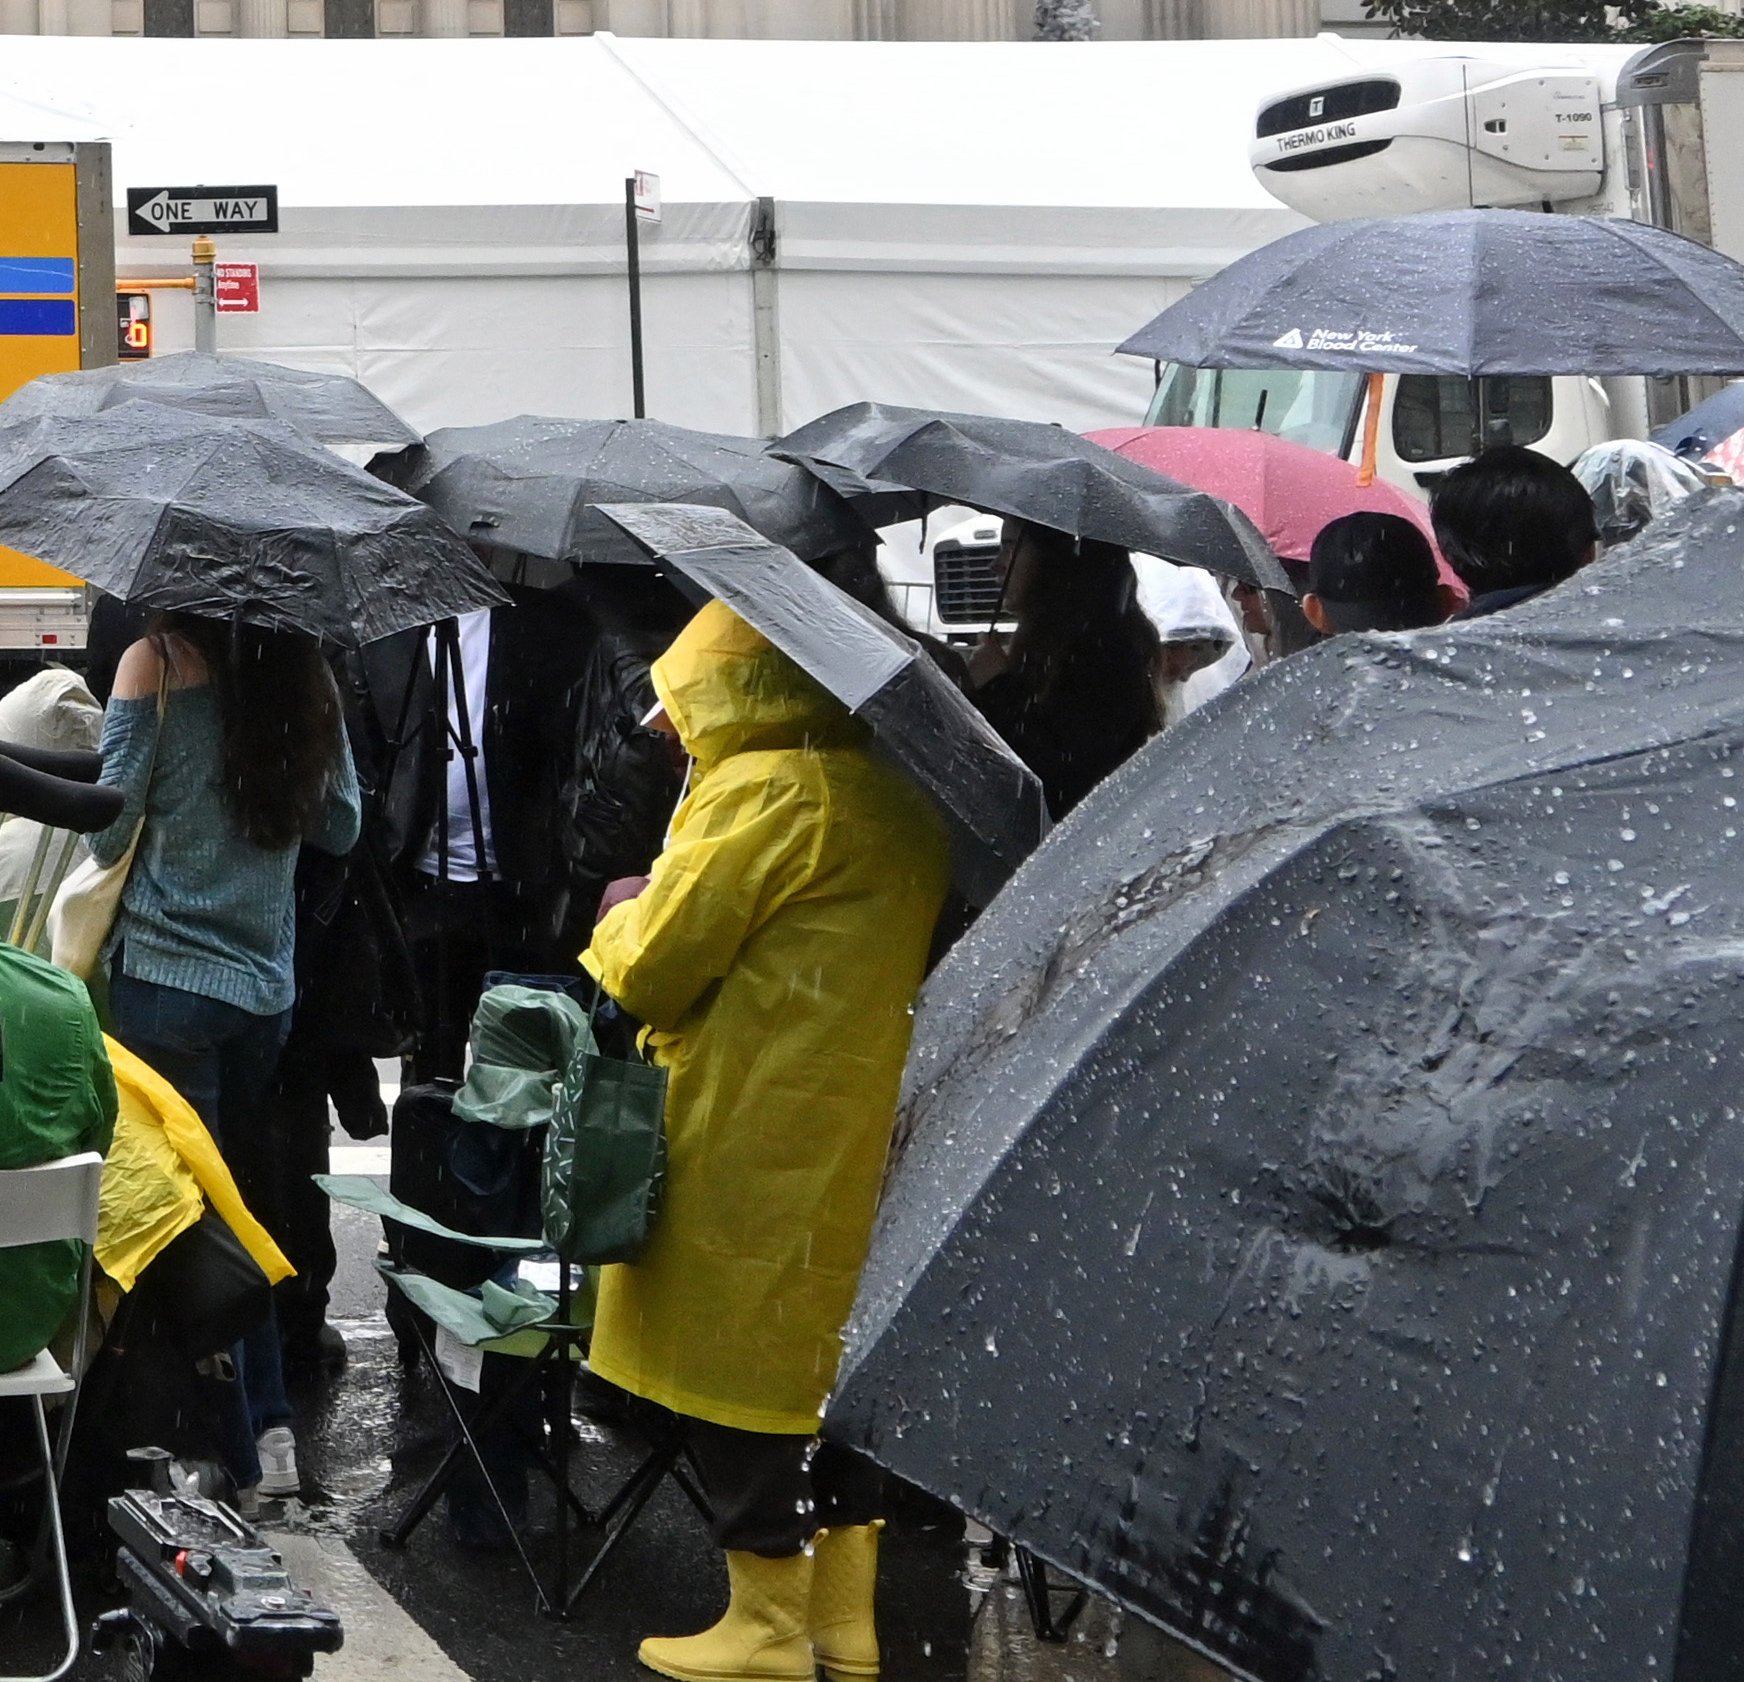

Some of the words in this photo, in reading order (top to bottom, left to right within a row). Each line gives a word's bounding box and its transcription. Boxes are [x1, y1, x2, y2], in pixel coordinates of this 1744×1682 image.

[1277, 129, 1325, 153] THERMO
[1327, 122, 1356, 141] KING
[151, 201, 193, 221] ONE
[214, 200, 258, 220] WAY
[1312, 328, 1354, 340] New
[1357, 330, 1396, 342] York
[1306, 338, 1358, 351] Blood
[1359, 341, 1418, 353] Center
